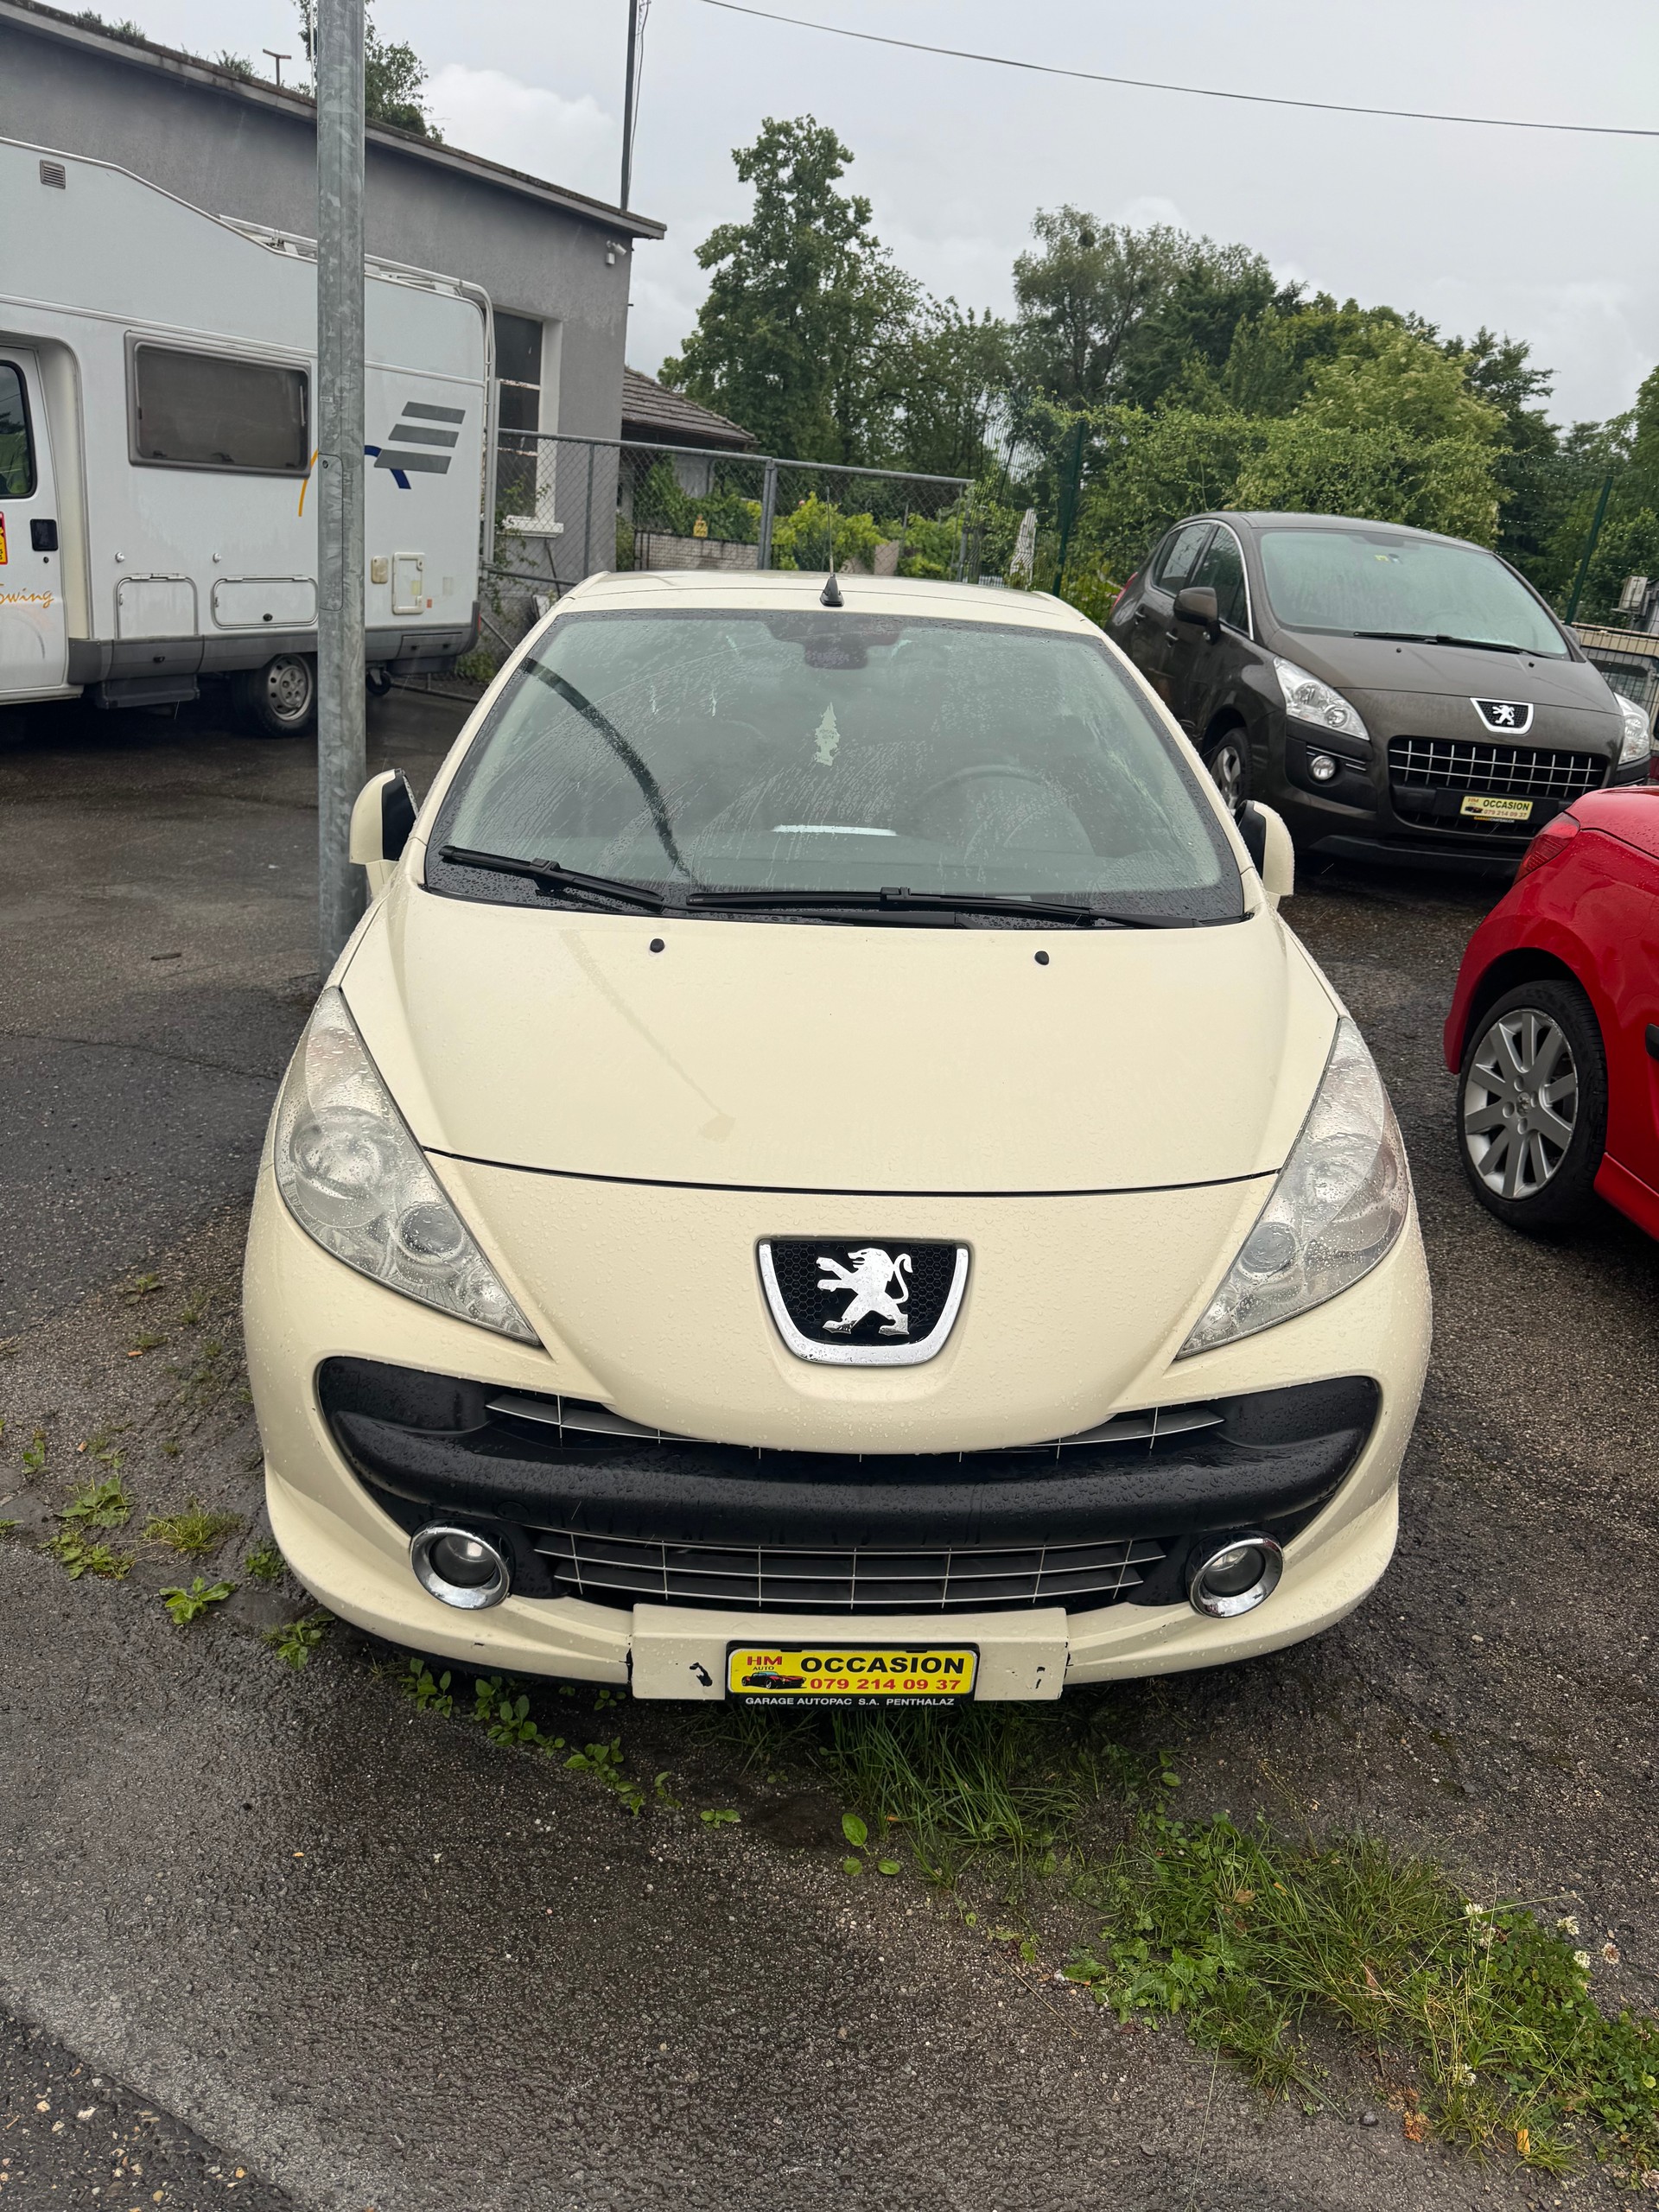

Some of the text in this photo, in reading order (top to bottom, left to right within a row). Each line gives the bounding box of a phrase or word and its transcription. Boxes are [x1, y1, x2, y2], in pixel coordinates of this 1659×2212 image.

[1483, 799, 1530, 810] OCCASION
[747, 1656, 783, 1666] HM
[800, 1656, 965, 1675] OCCASION
[810, 1678, 961, 1690] 079 214 09 37
